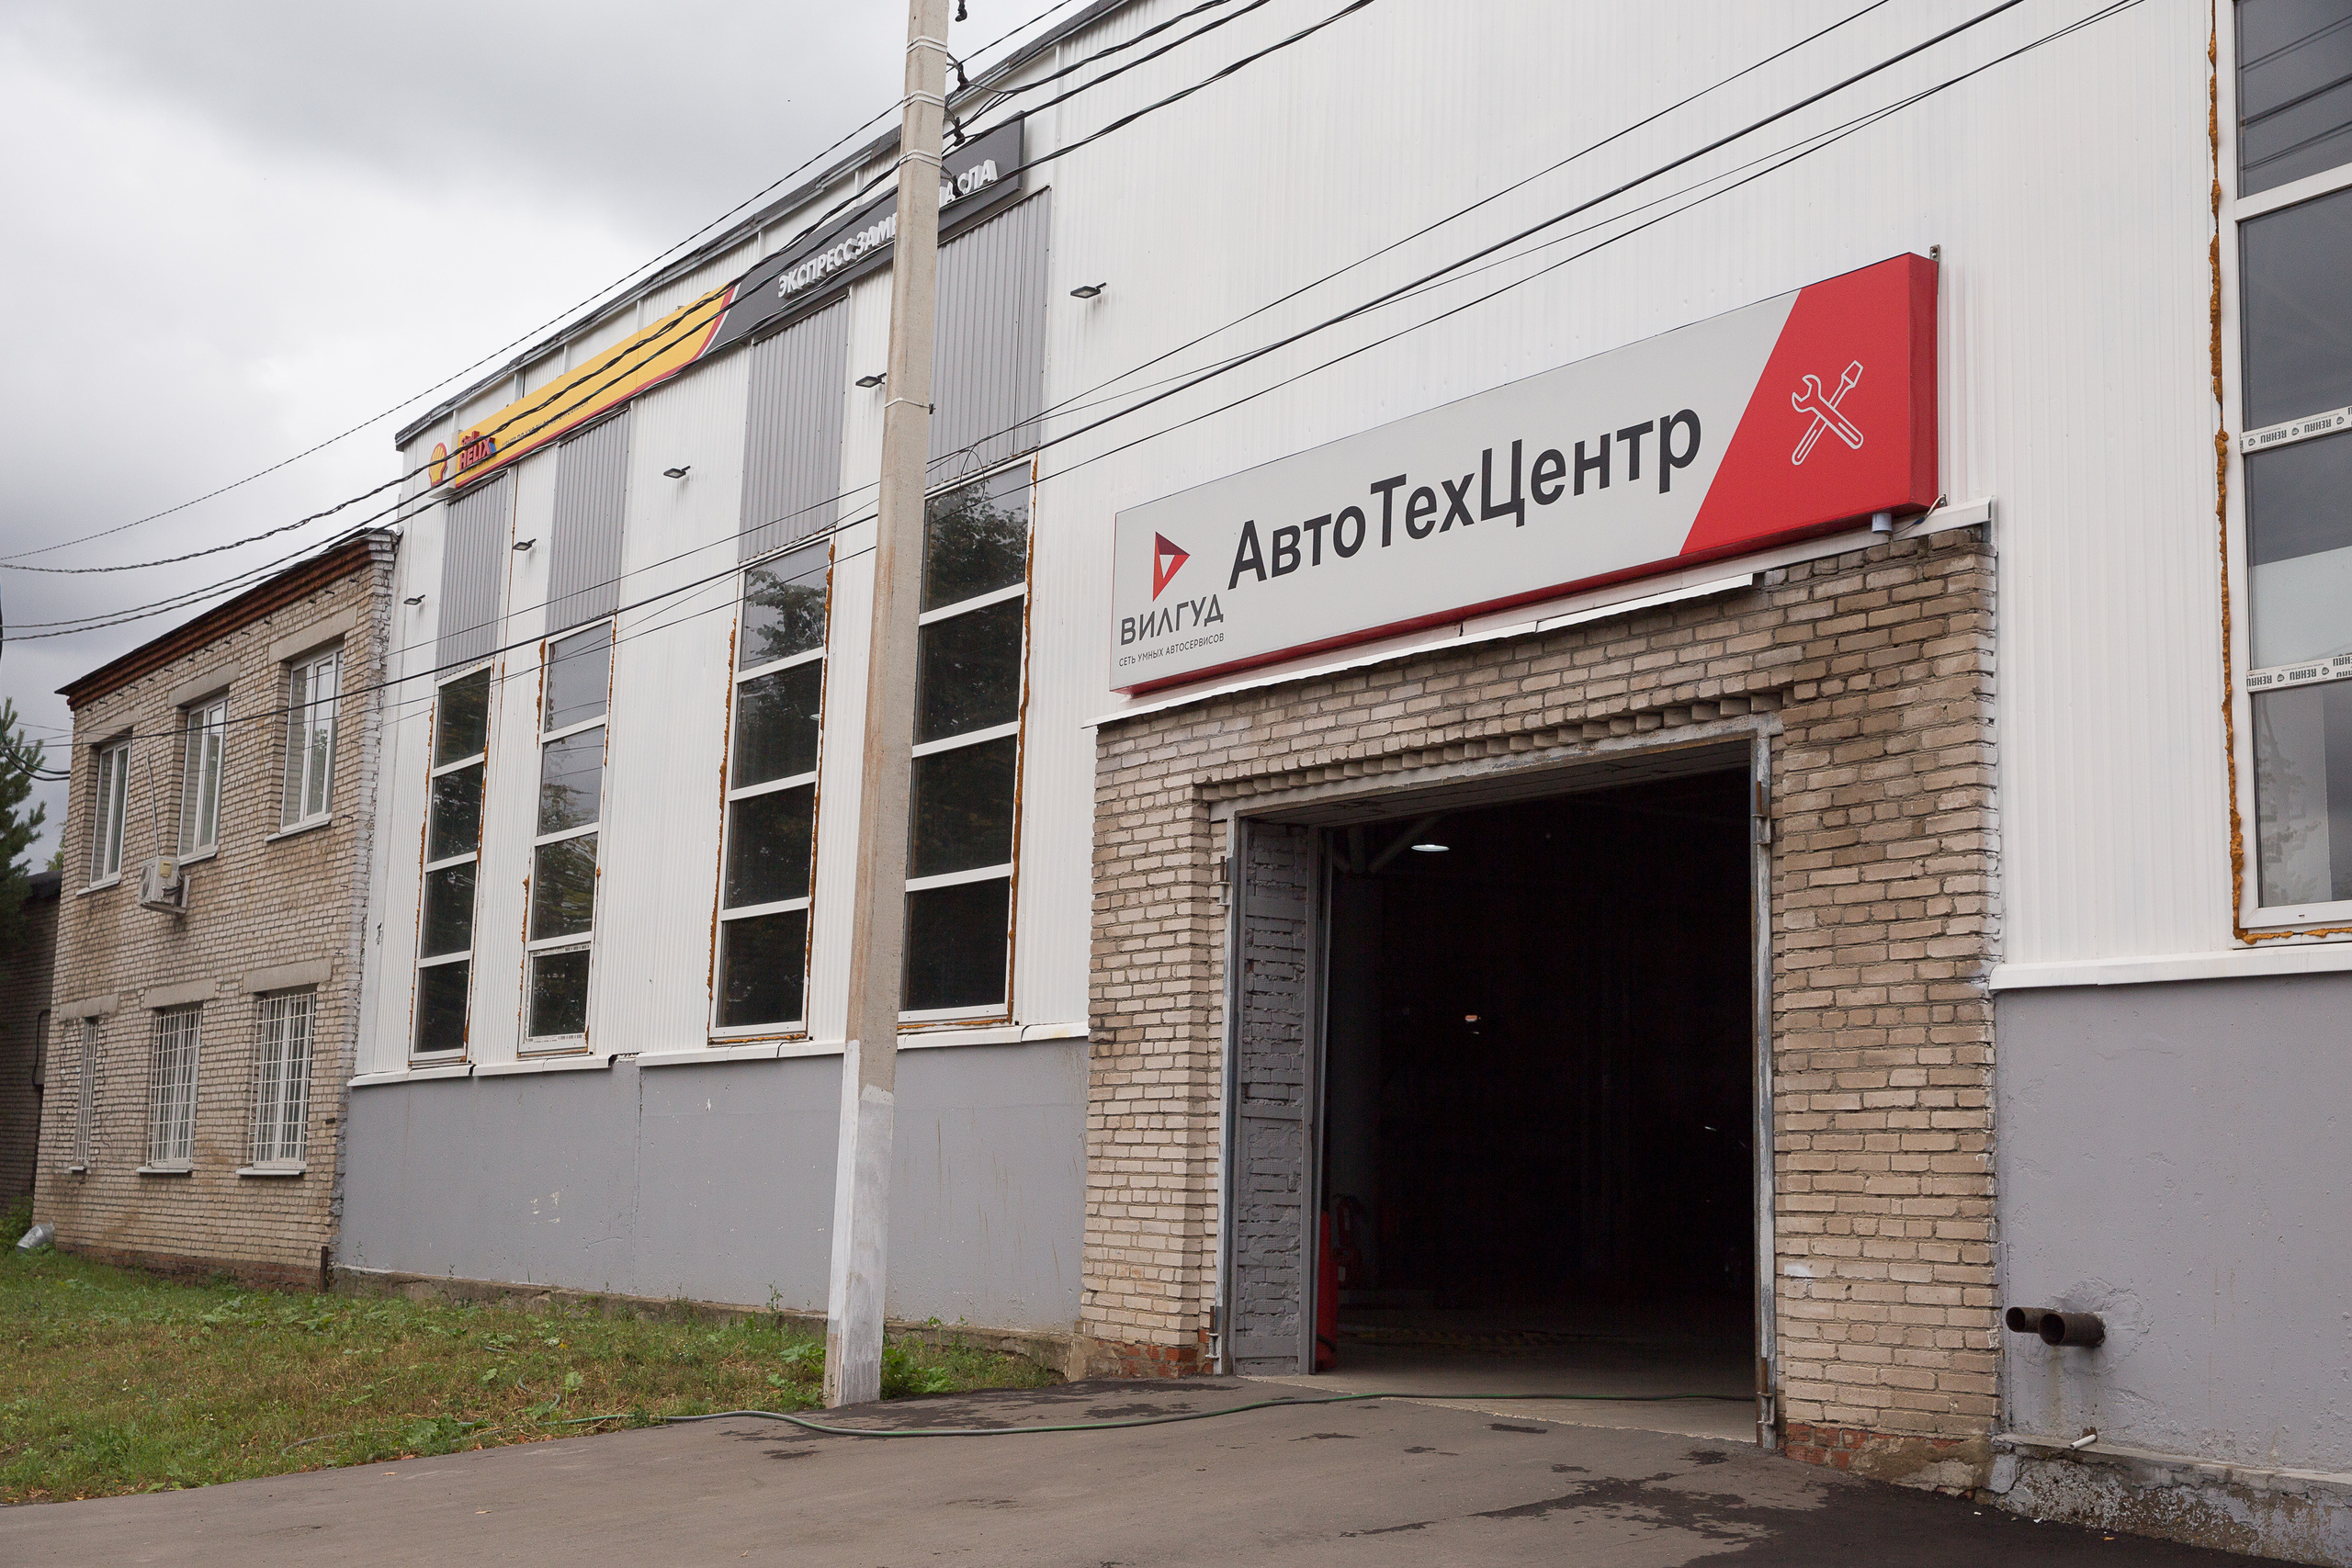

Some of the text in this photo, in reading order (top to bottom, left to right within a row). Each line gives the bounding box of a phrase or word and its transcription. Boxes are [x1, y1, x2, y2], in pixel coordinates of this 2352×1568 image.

[778, 238, 856, 298] ЭКСПРЕСС
[855, 212, 897, 255] ЗАМ
[2260, 429, 2287, 444] REHAU
[2304, 419, 2332, 434] REHAU
[459, 437, 493, 470] HELIX
[1227, 409, 1702, 591] АвтоТехЦентр
[1121, 593, 1224, 646] ВИЛГУД
[1118, 632, 1225, 667] СЕТЬ УМНЫХ АВТОСЕРВИСОВ
[2246, 674, 2272, 687] REHAU
[2290, 668, 2317, 681] REHAU
